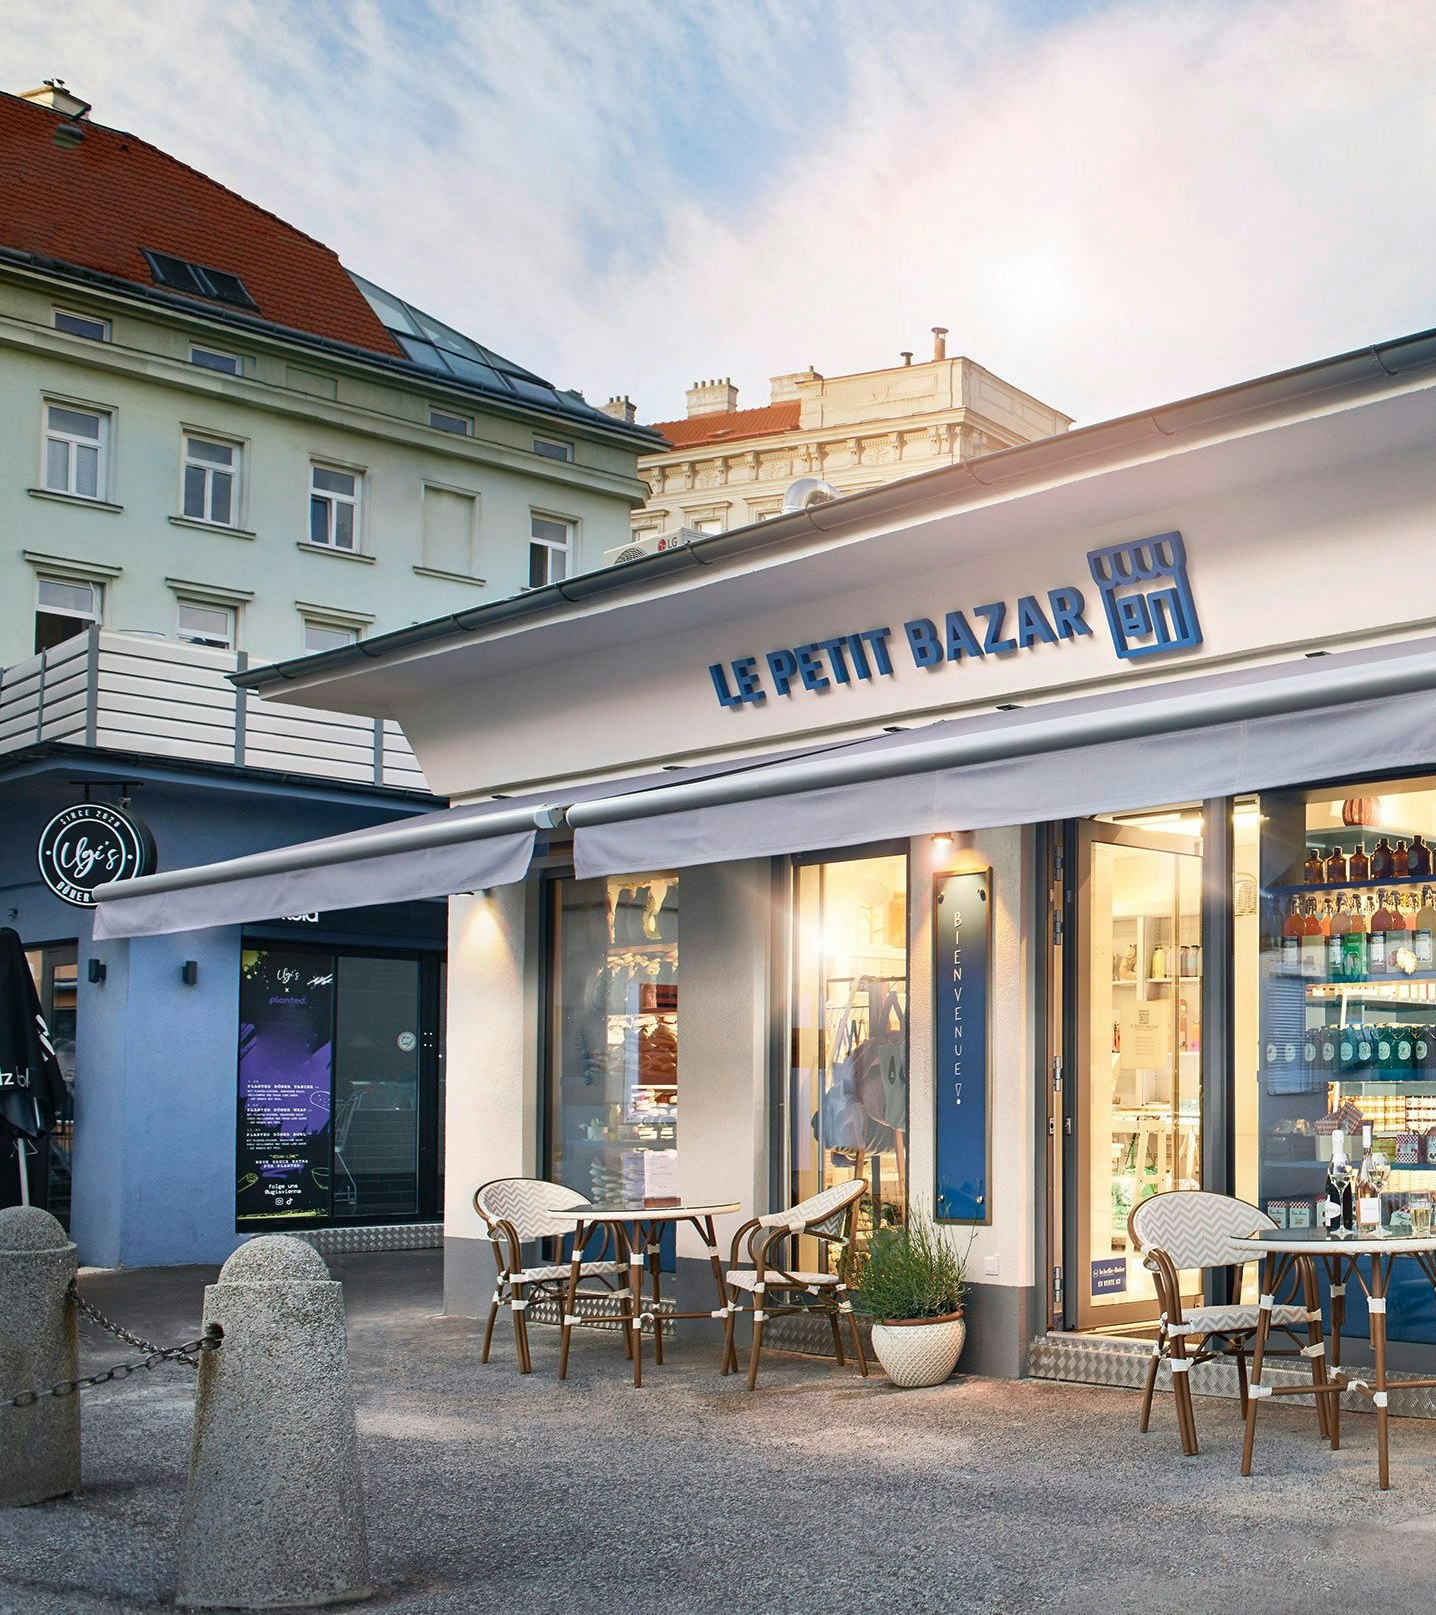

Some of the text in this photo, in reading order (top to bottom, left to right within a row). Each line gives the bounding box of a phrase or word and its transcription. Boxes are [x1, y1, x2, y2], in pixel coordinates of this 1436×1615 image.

[707, 586, 1094, 708] LE PETIT BAZAR
[60, 809, 121, 828] SINCE 2020
[60, 836, 120, 879] Ugi's
[56, 881, 90, 903] DÖNER
